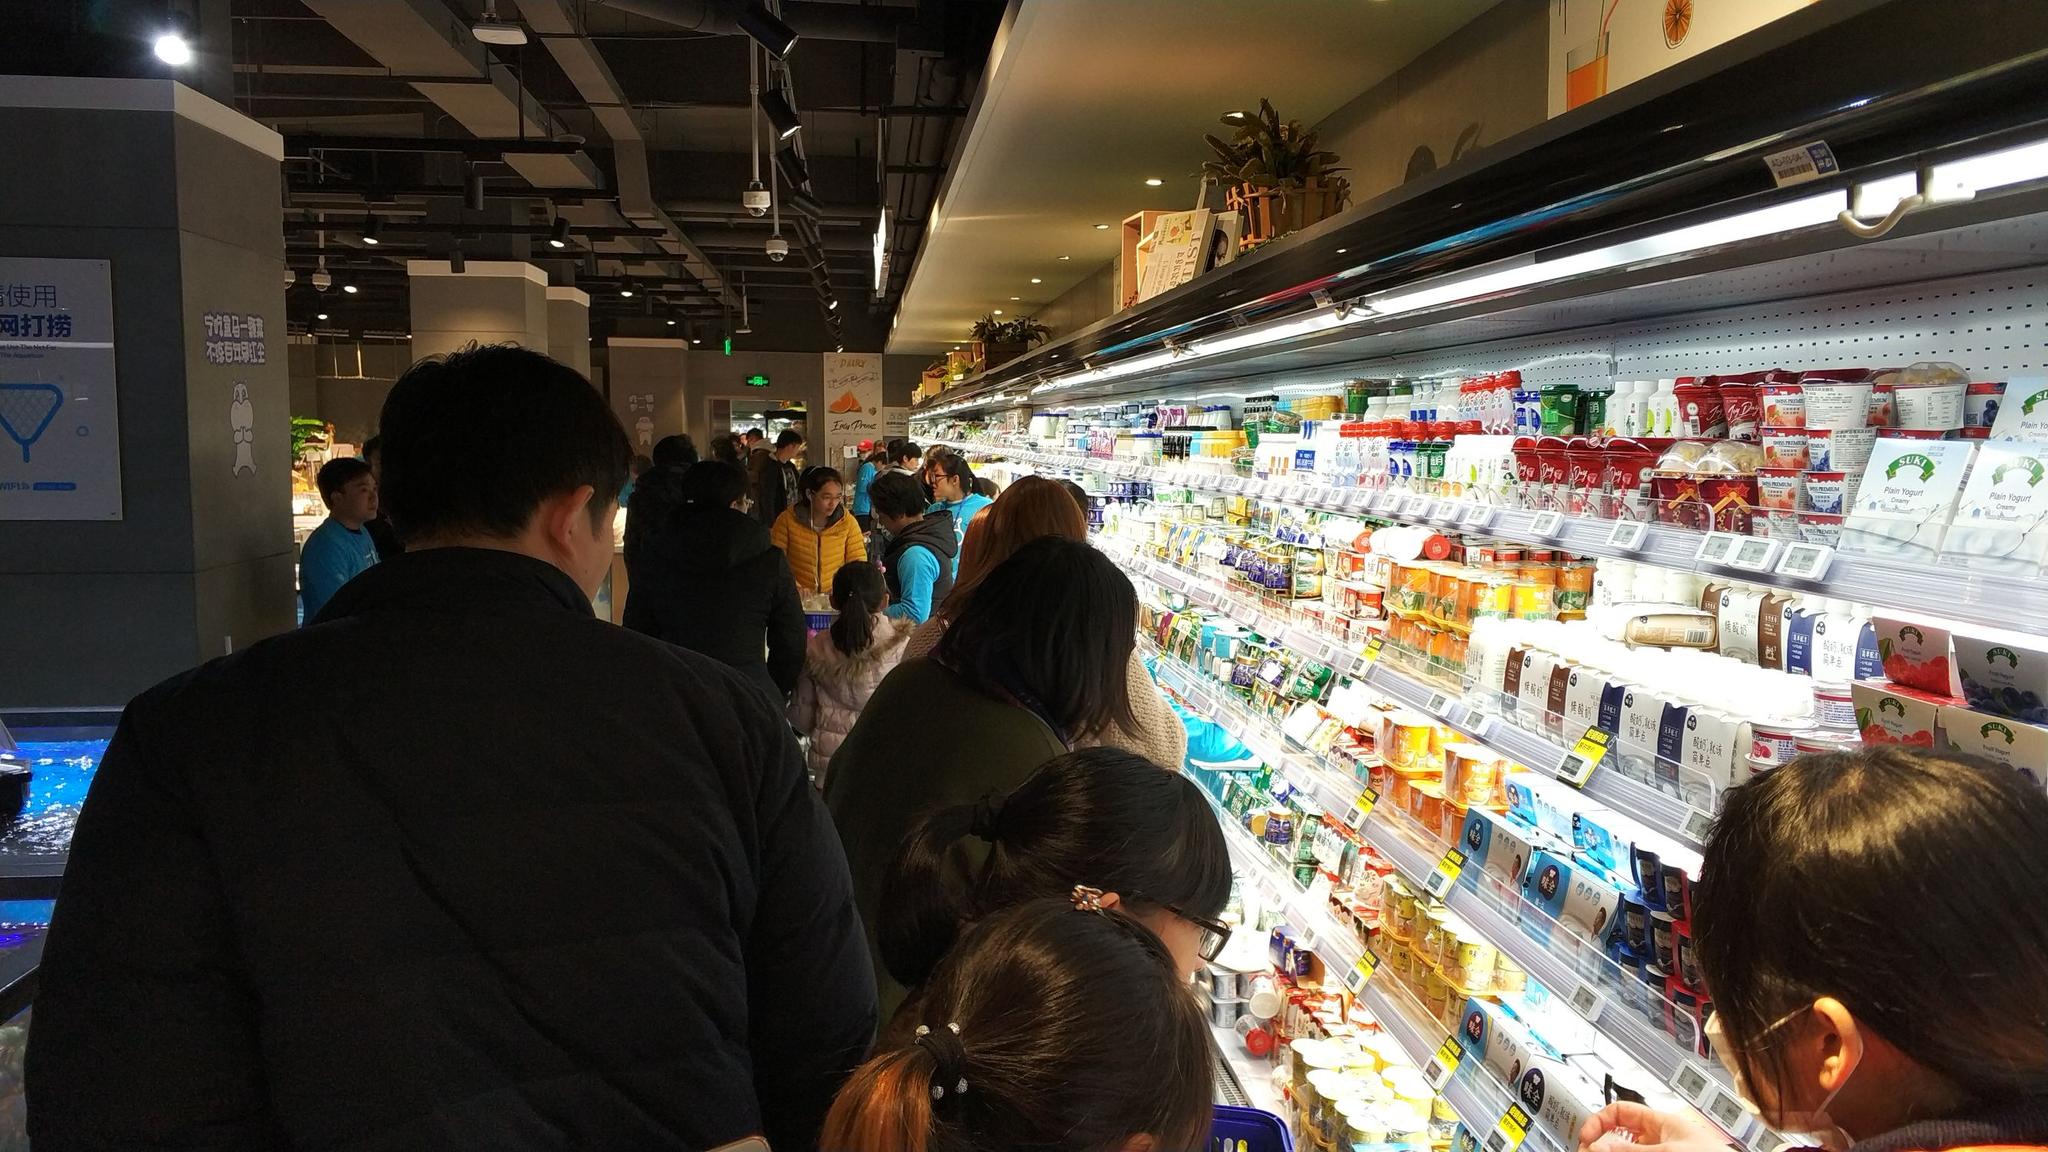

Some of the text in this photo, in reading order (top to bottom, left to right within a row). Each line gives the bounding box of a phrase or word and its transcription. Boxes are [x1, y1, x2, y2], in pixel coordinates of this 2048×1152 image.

[1898, 456, 1927, 468] SUKI
[1884, 486, 1923, 497] Plain Yogurt
[1989, 492, 2032, 503] Plain Yogurt
[1540, 877, 1556, 894] 味全
[1469, 1020, 1480, 1038] 味全
[1524, 1080, 1540, 1106] 味全
